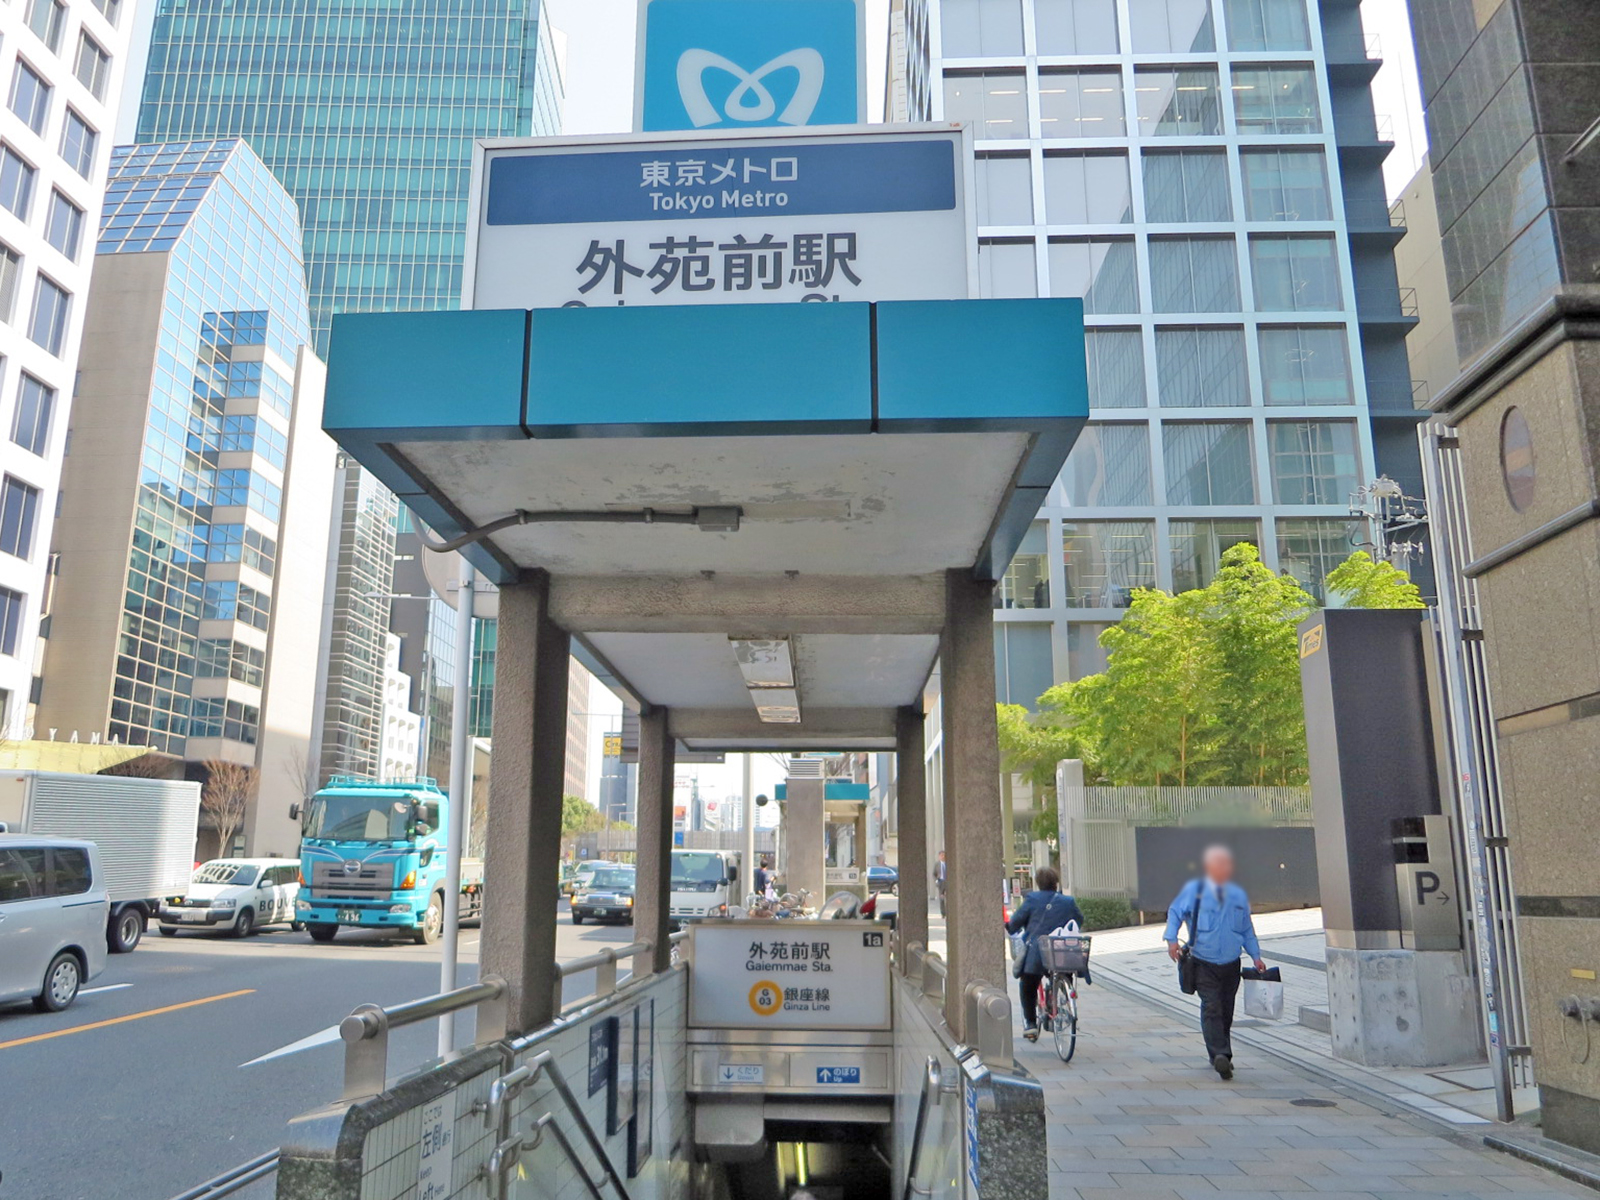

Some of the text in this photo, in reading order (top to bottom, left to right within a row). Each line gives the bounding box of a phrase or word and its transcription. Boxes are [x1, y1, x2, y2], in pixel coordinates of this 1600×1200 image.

[640, 157, 798, 188] 東京メトロ
[649, 188, 789, 213] Tokyo Metro
[575, 232, 862, 295] 外苑前駅
[1415, 871, 1440, 905] P
[865, 933, 882, 946] 1a
[749, 941, 830, 960] 外苑前駅
[745, 960, 834, 972] Gaiemmae Sta.
[762, 988, 769, 997] G
[784, 987, 830, 1002] 銀座線
[758, 997, 772, 1006] 03
[783, 1002, 830, 1011] Ginza Line
[737, 1066, 760, 1075] くだり
[833, 1067, 857, 1077] のぼり
